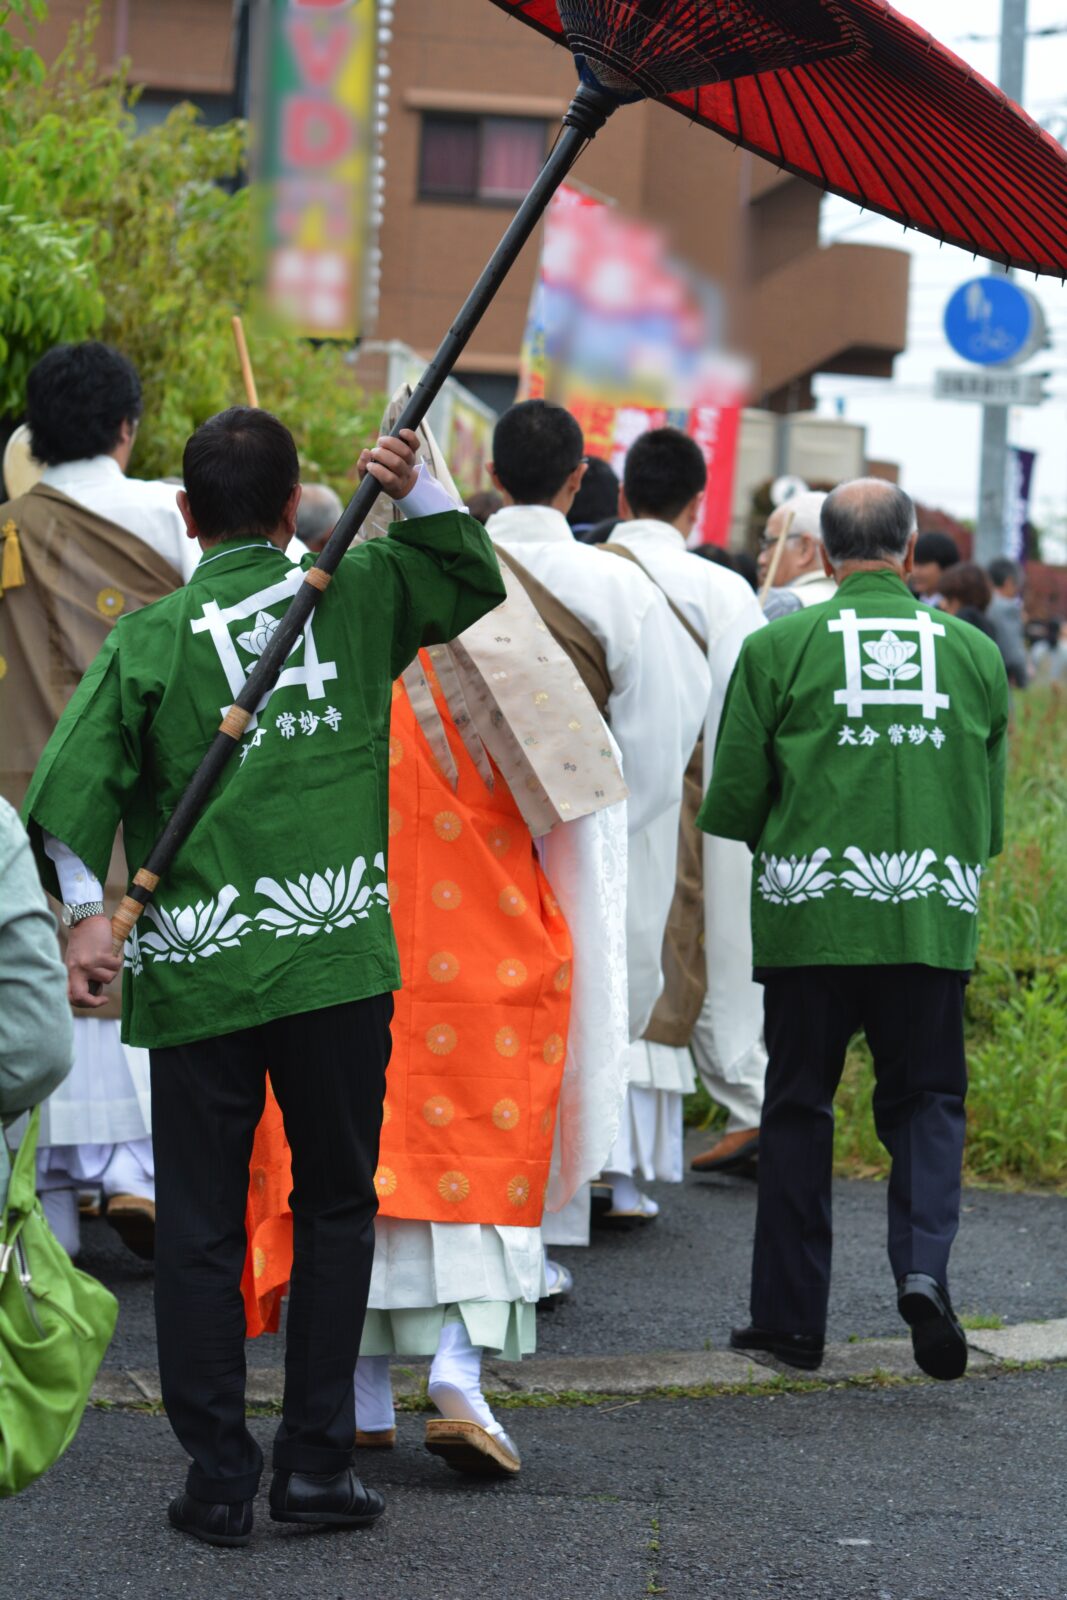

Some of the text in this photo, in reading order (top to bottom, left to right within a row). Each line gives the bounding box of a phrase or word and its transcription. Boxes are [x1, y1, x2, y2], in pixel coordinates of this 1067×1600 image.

[275, 705, 343, 740] 常妙寺
[837, 723, 946, 750] 大分 常妙寺
